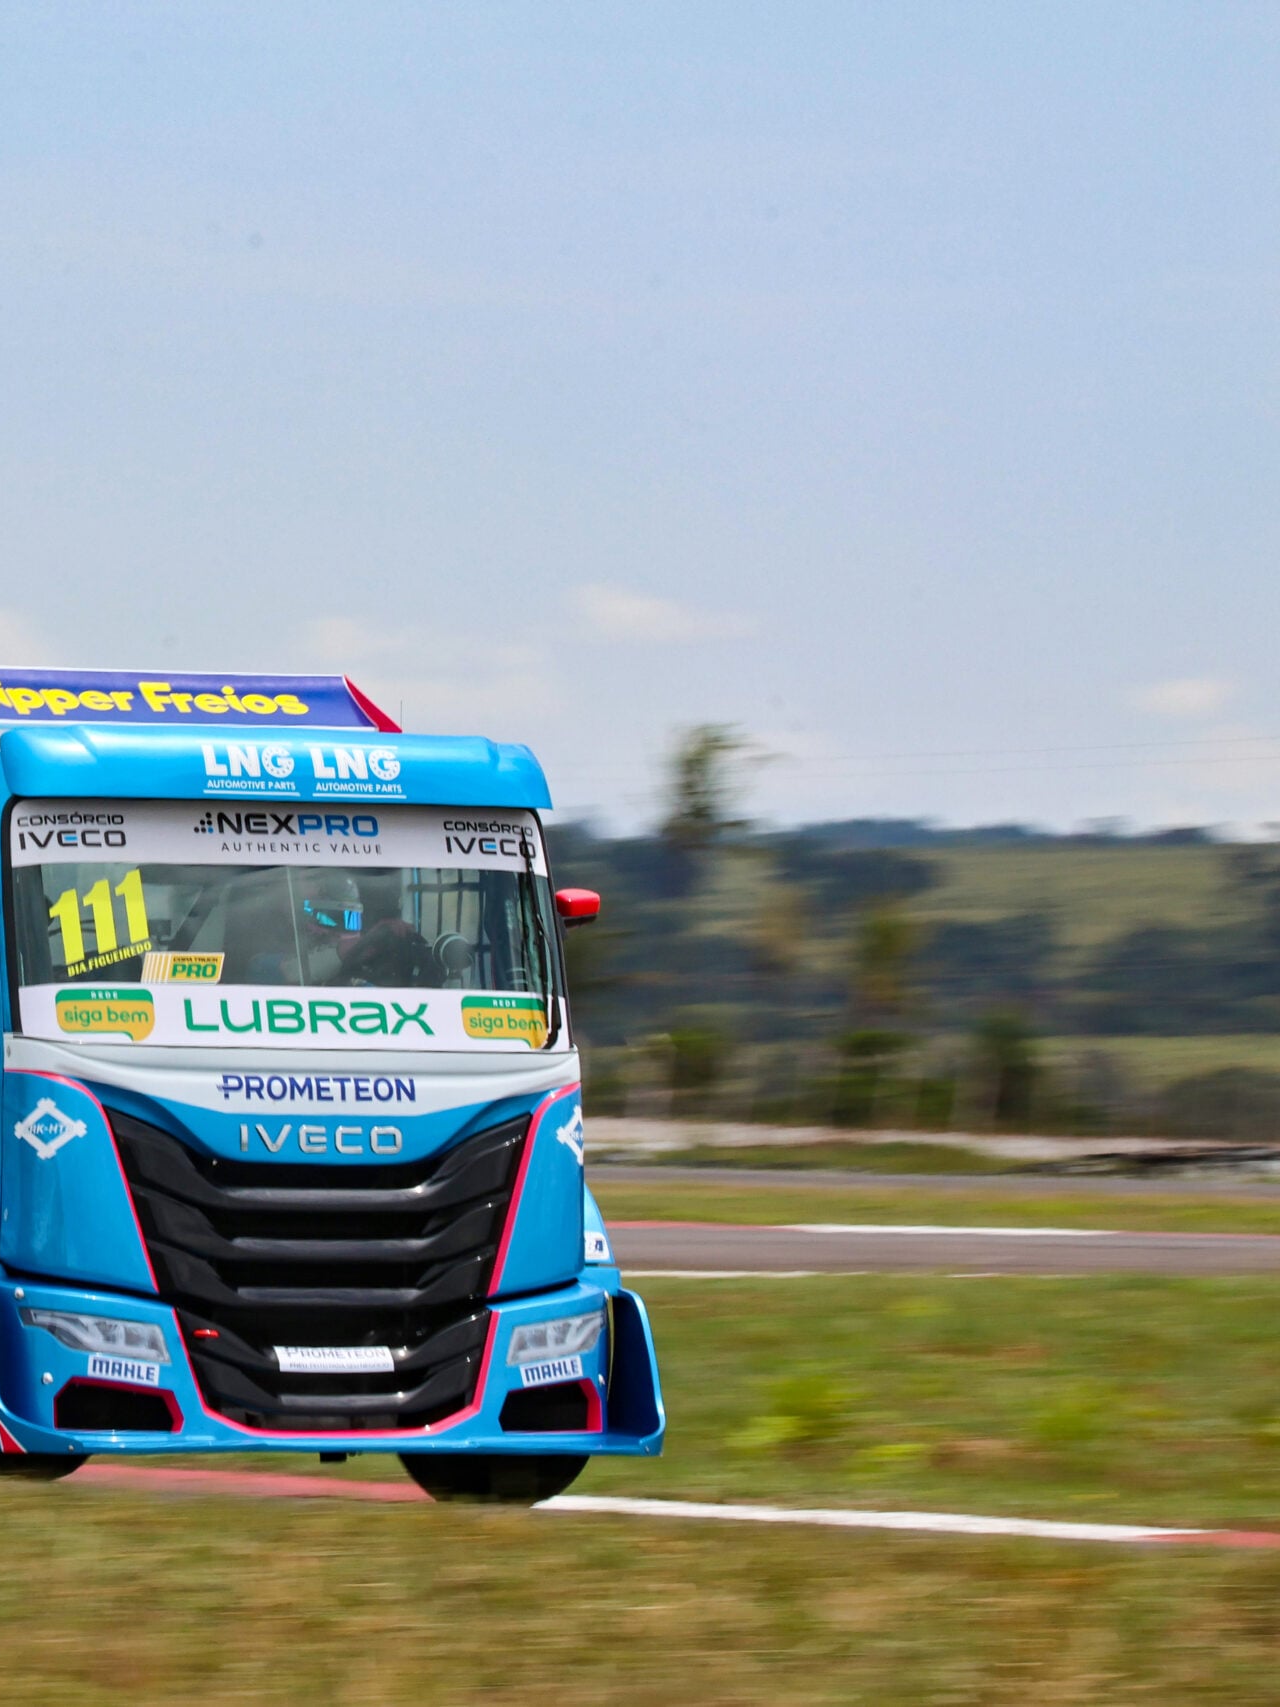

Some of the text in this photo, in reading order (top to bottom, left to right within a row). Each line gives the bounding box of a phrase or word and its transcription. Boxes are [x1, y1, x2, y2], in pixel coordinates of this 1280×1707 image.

[138, 682, 310, 715] Freios
[201, 743, 295, 778] LNG
[310, 748, 401, 781] LNG
[207, 779, 296, 791] AUTOMOTIVE PARTS
[315, 782, 402, 794] AUTOMOTIVE PARTS
[17, 811, 125, 827] CONSÓRCIO
[217, 811, 379, 838] NEXPRO
[19, 829, 127, 851] IVECO
[221, 841, 382, 856] AUTHENTIC VALUE
[446, 834, 536, 859] IVECO
[49, 868, 149, 966] 111
[67, 941, 152, 977] BIA FIGUEIREDO
[171, 964, 217, 978] PRO
[90, 991, 119, 1000] REDE
[492, 999, 517, 1008] REDE
[64, 1006, 149, 1027] siga bem
[469, 1012, 544, 1034] siga bem
[218, 1074, 416, 1101] PROMETEON
[239, 1123, 403, 1155] IVECO
[92, 1357, 155, 1381] MAHLE
[524, 1358, 579, 1383] MAHLE
